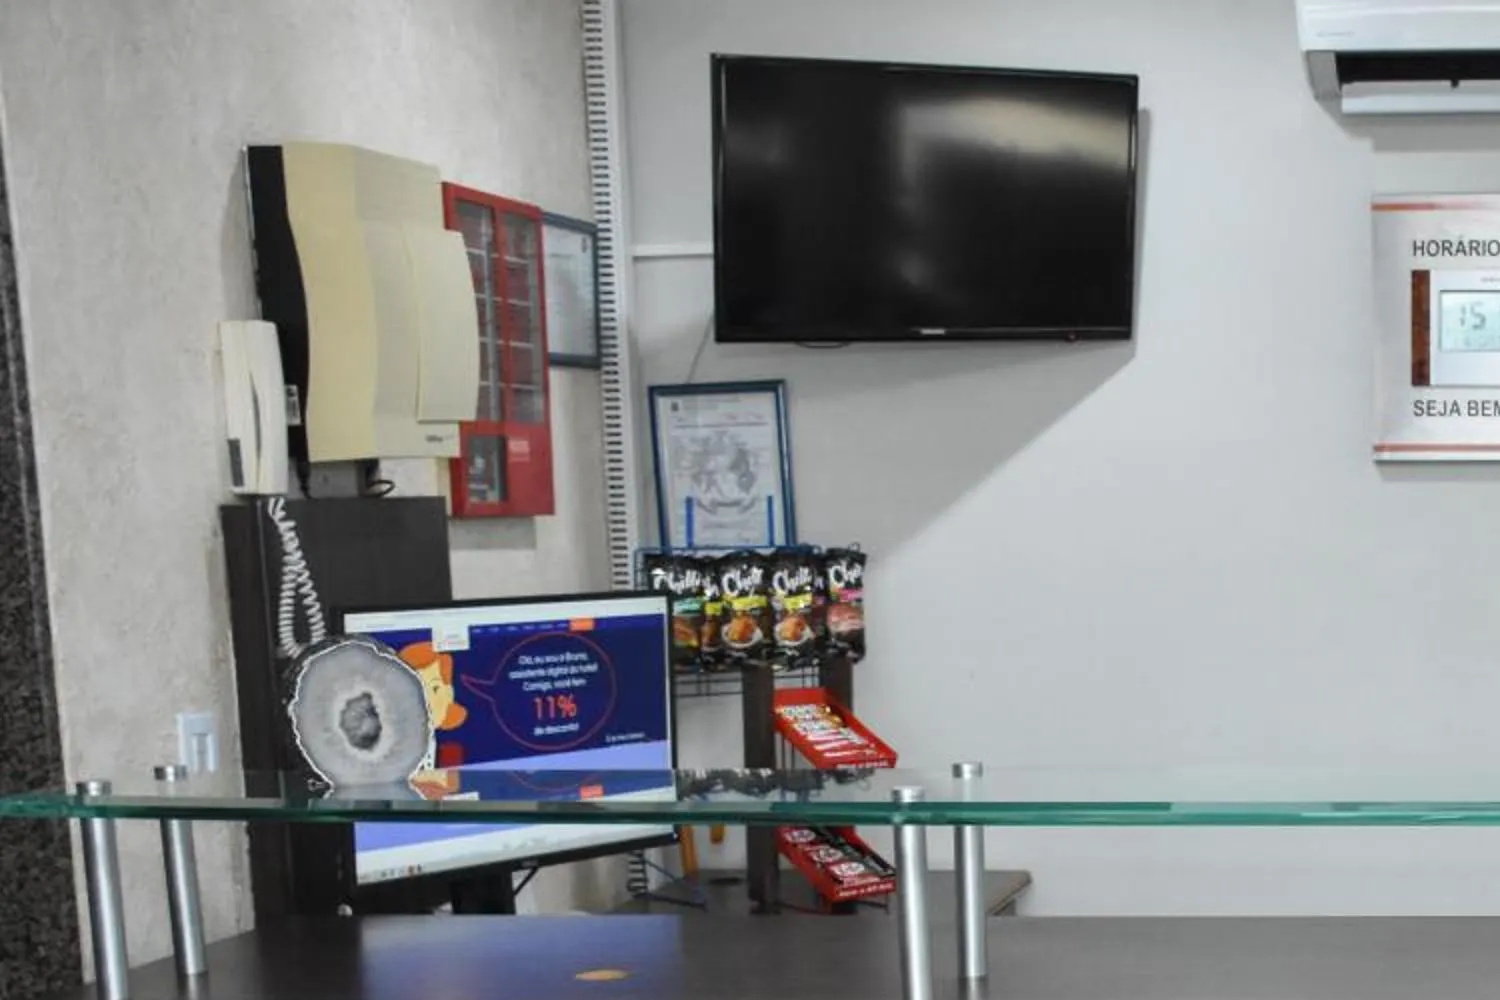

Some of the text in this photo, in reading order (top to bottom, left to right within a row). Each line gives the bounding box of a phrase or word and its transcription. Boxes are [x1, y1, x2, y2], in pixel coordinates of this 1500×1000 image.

[1412, 235, 1500, 257] HORÁRIO
[1413, 400, 1461, 417] SEJA
[534, 694, 577, 720] 11%
